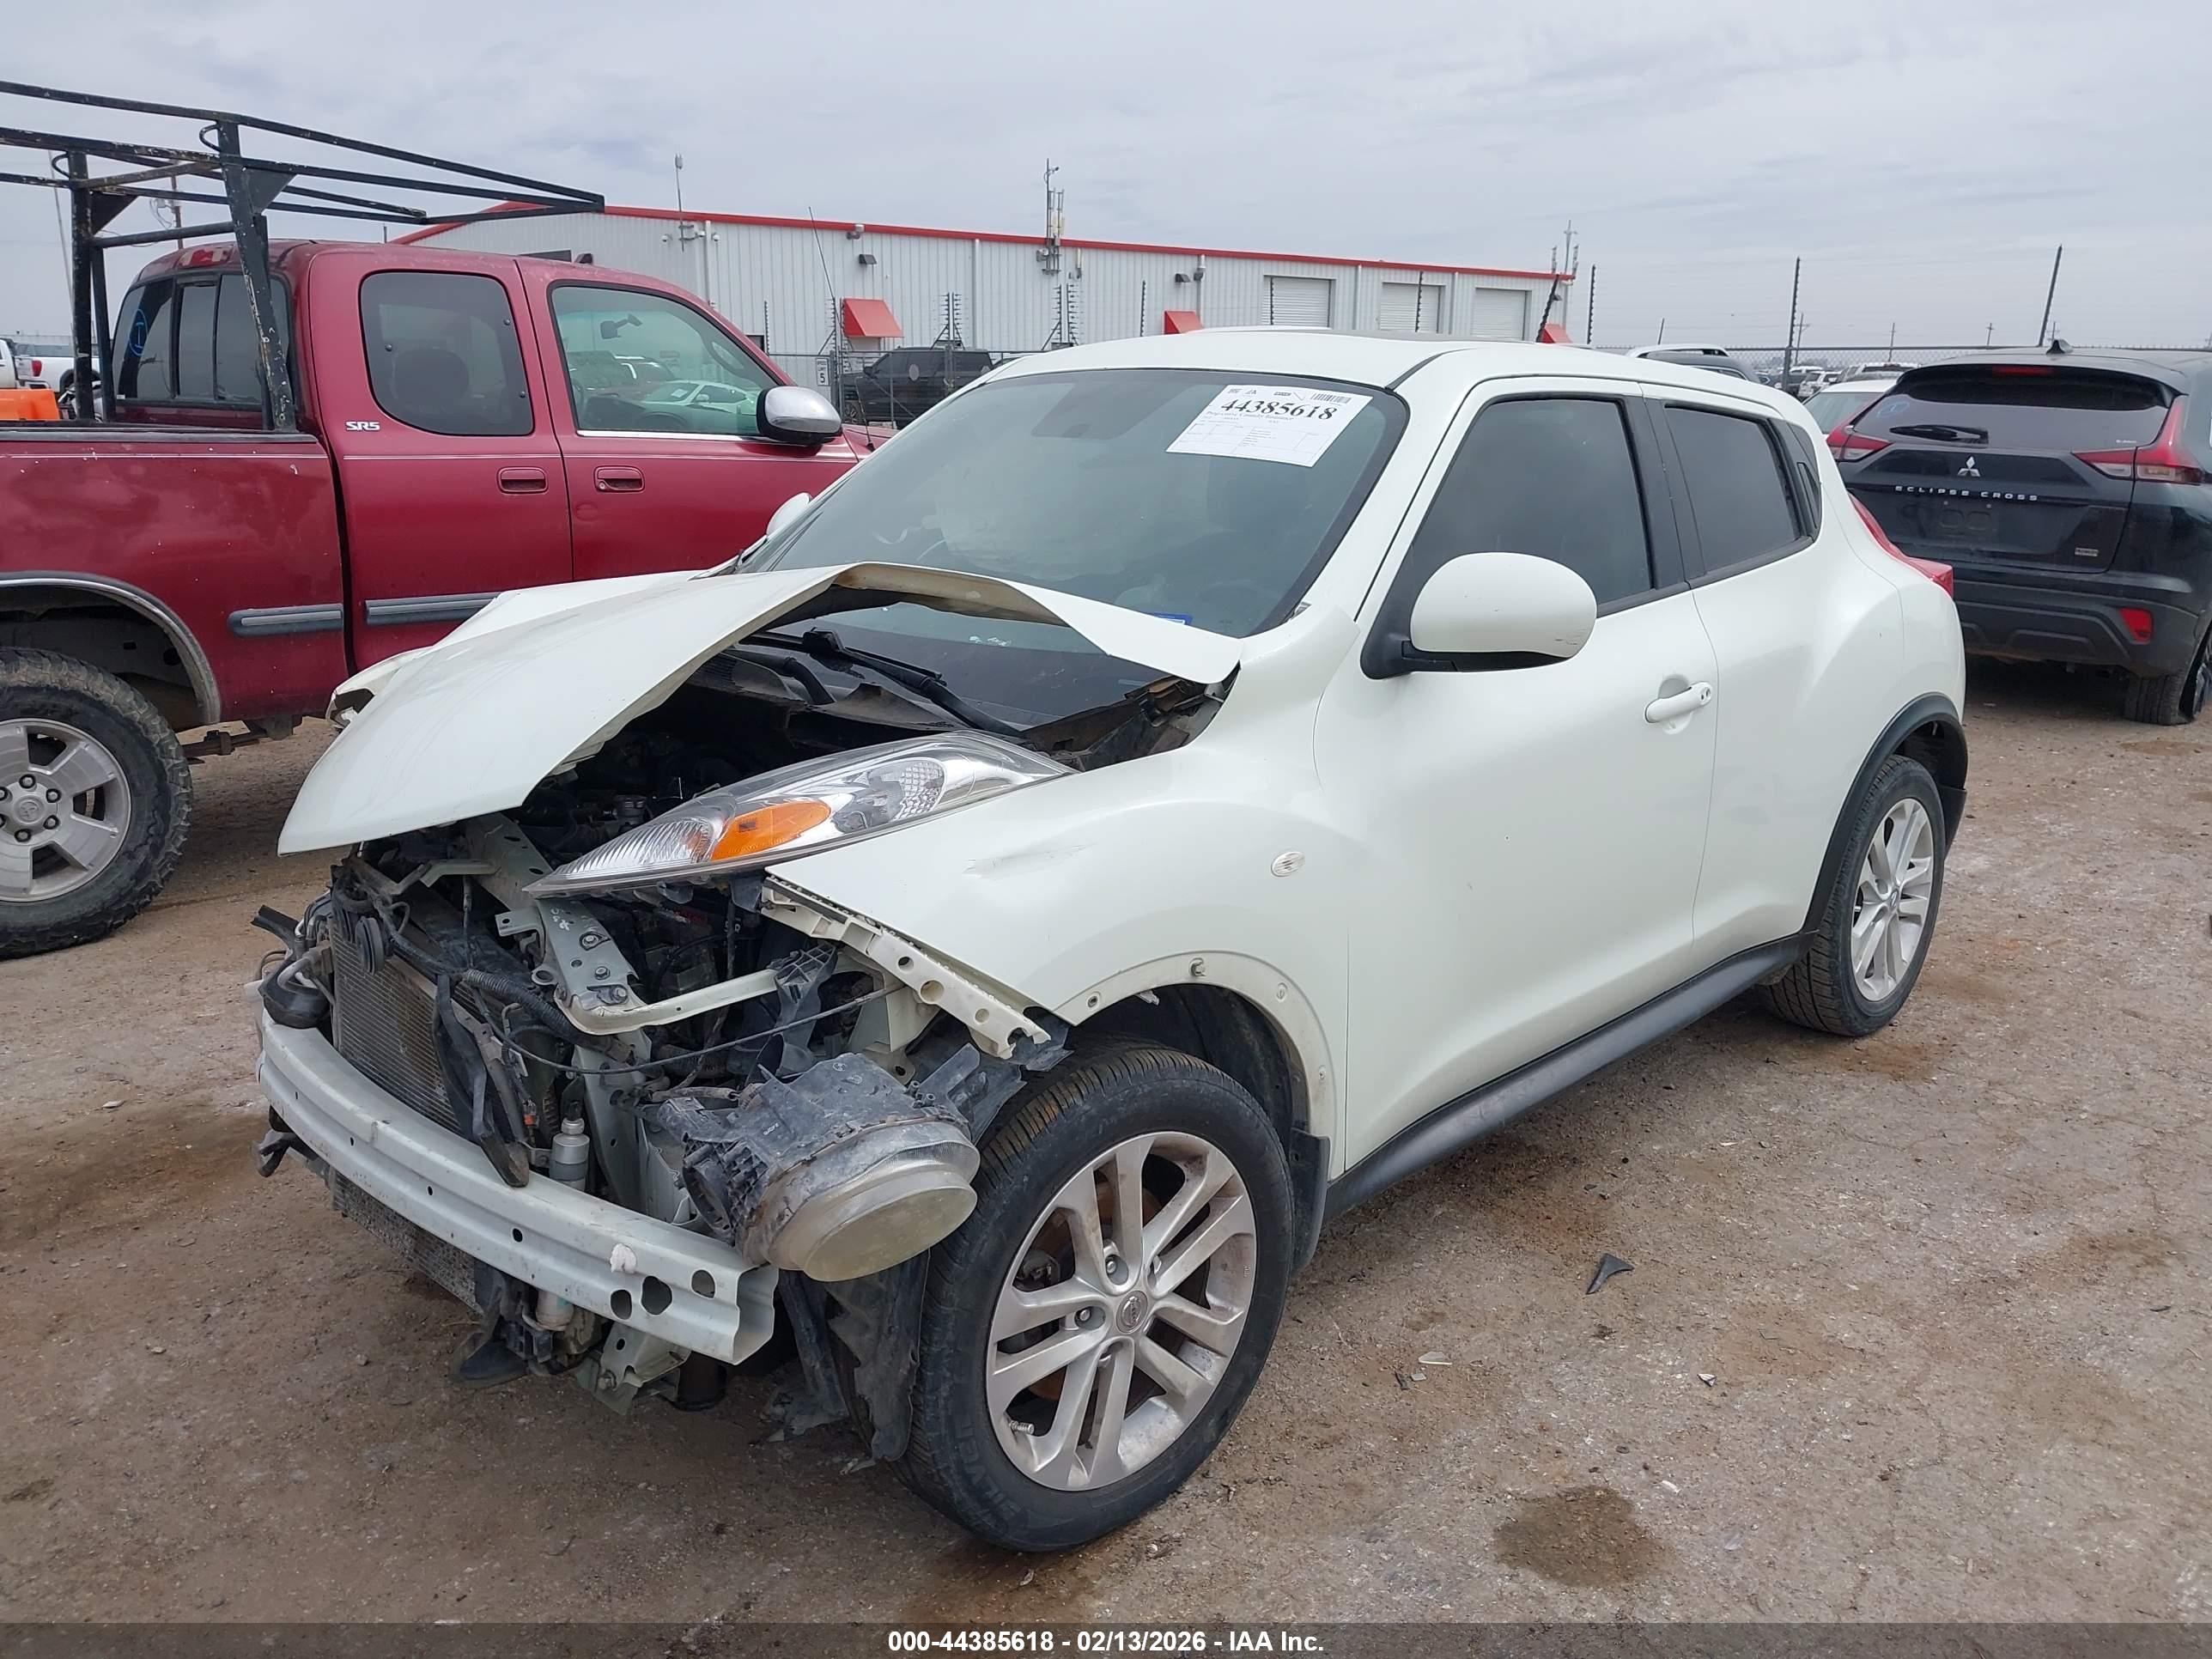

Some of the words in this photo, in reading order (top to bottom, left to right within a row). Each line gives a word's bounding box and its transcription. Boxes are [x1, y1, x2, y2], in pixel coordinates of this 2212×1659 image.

[819, 373, 826, 383] 5
[1220, 398, 1338, 420] 44385618
[345, 421, 381, 431] SR5
[1895, 485, 1970, 496] ECLIPSE
[1980, 491, 2039, 501] CROSS
